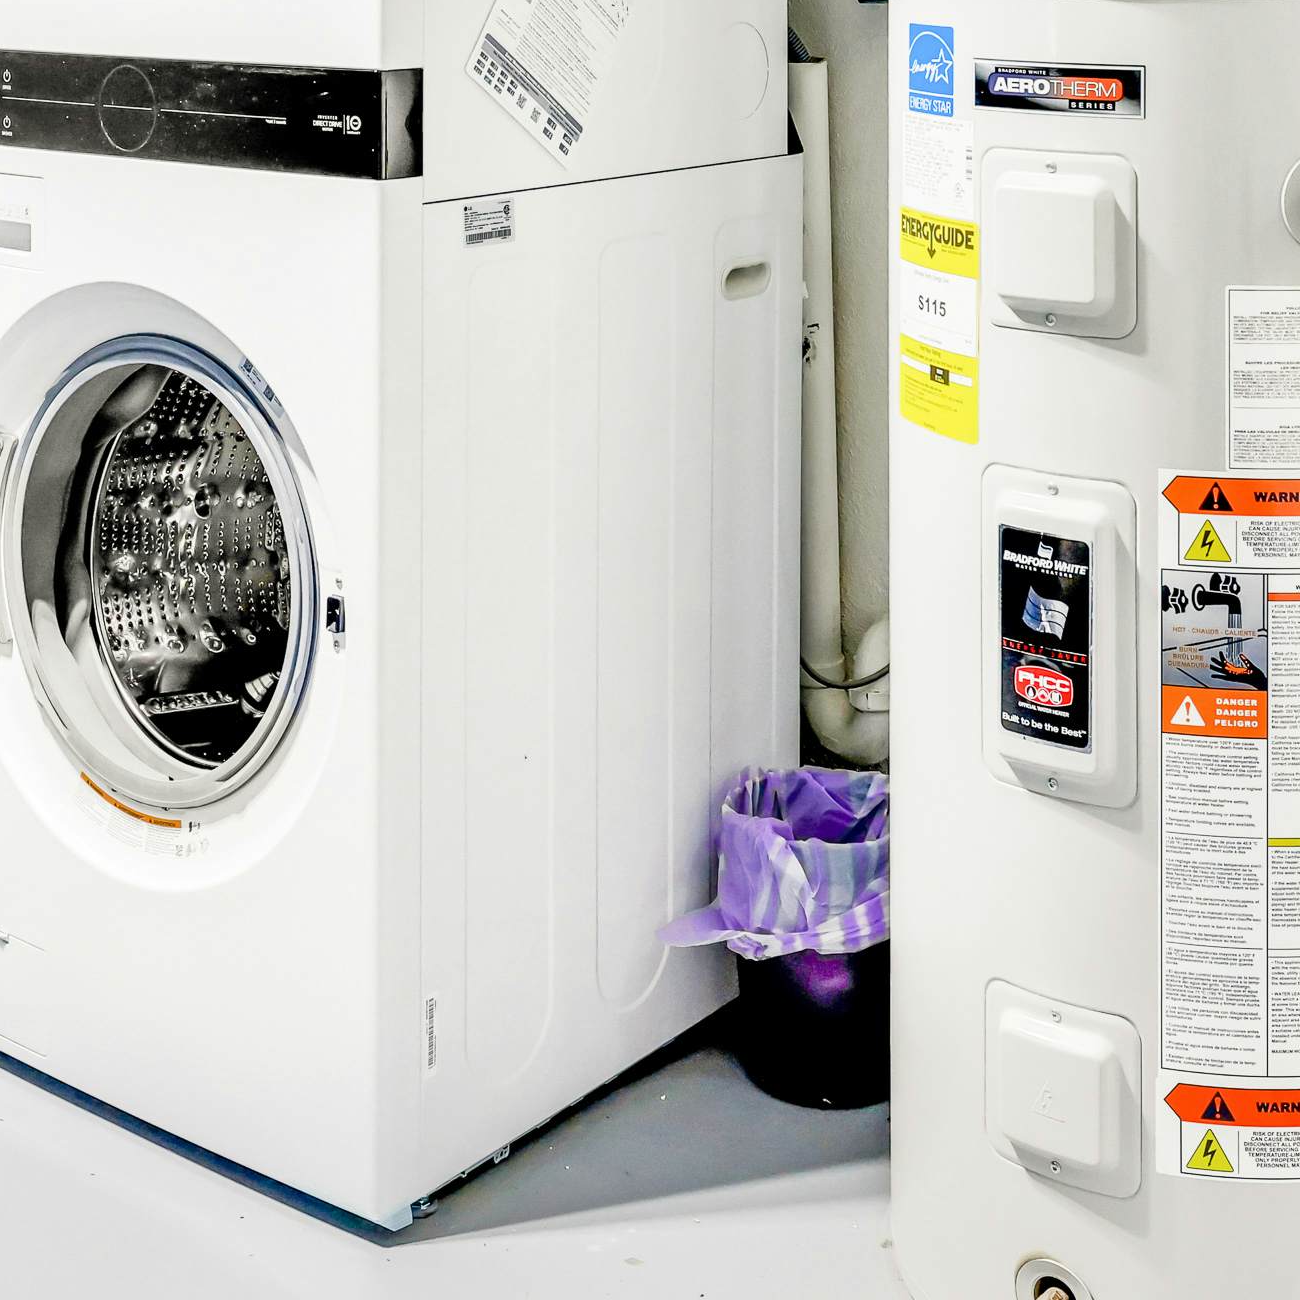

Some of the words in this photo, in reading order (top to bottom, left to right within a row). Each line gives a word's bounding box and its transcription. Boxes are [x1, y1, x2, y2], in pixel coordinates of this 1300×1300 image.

[993, 76, 1116, 98] AEROTHERM
[909, 95, 933, 112] ENERGY
[933, 98, 952, 114] STAR
[1071, 101, 1113, 110] SERIES
[1003, 549, 1053, 569] BRADFORD
[1054, 560, 1088, 575] WHITE
[1225, 629, 1256, 637] CALIENTE
[1168, 661, 1209, 669] QUEMADURA
[1018, 670, 1070, 692] PHCC
[1216, 698, 1258, 706] DANGER
[1216, 708, 1258, 717] DANGER
[1002, 712, 1019, 723] Built
[1021, 717, 1030, 726] to
[1032, 719, 1042, 729] be
[1044, 723, 1059, 732] the
[1214, 719, 1258, 728] PELIGRO
